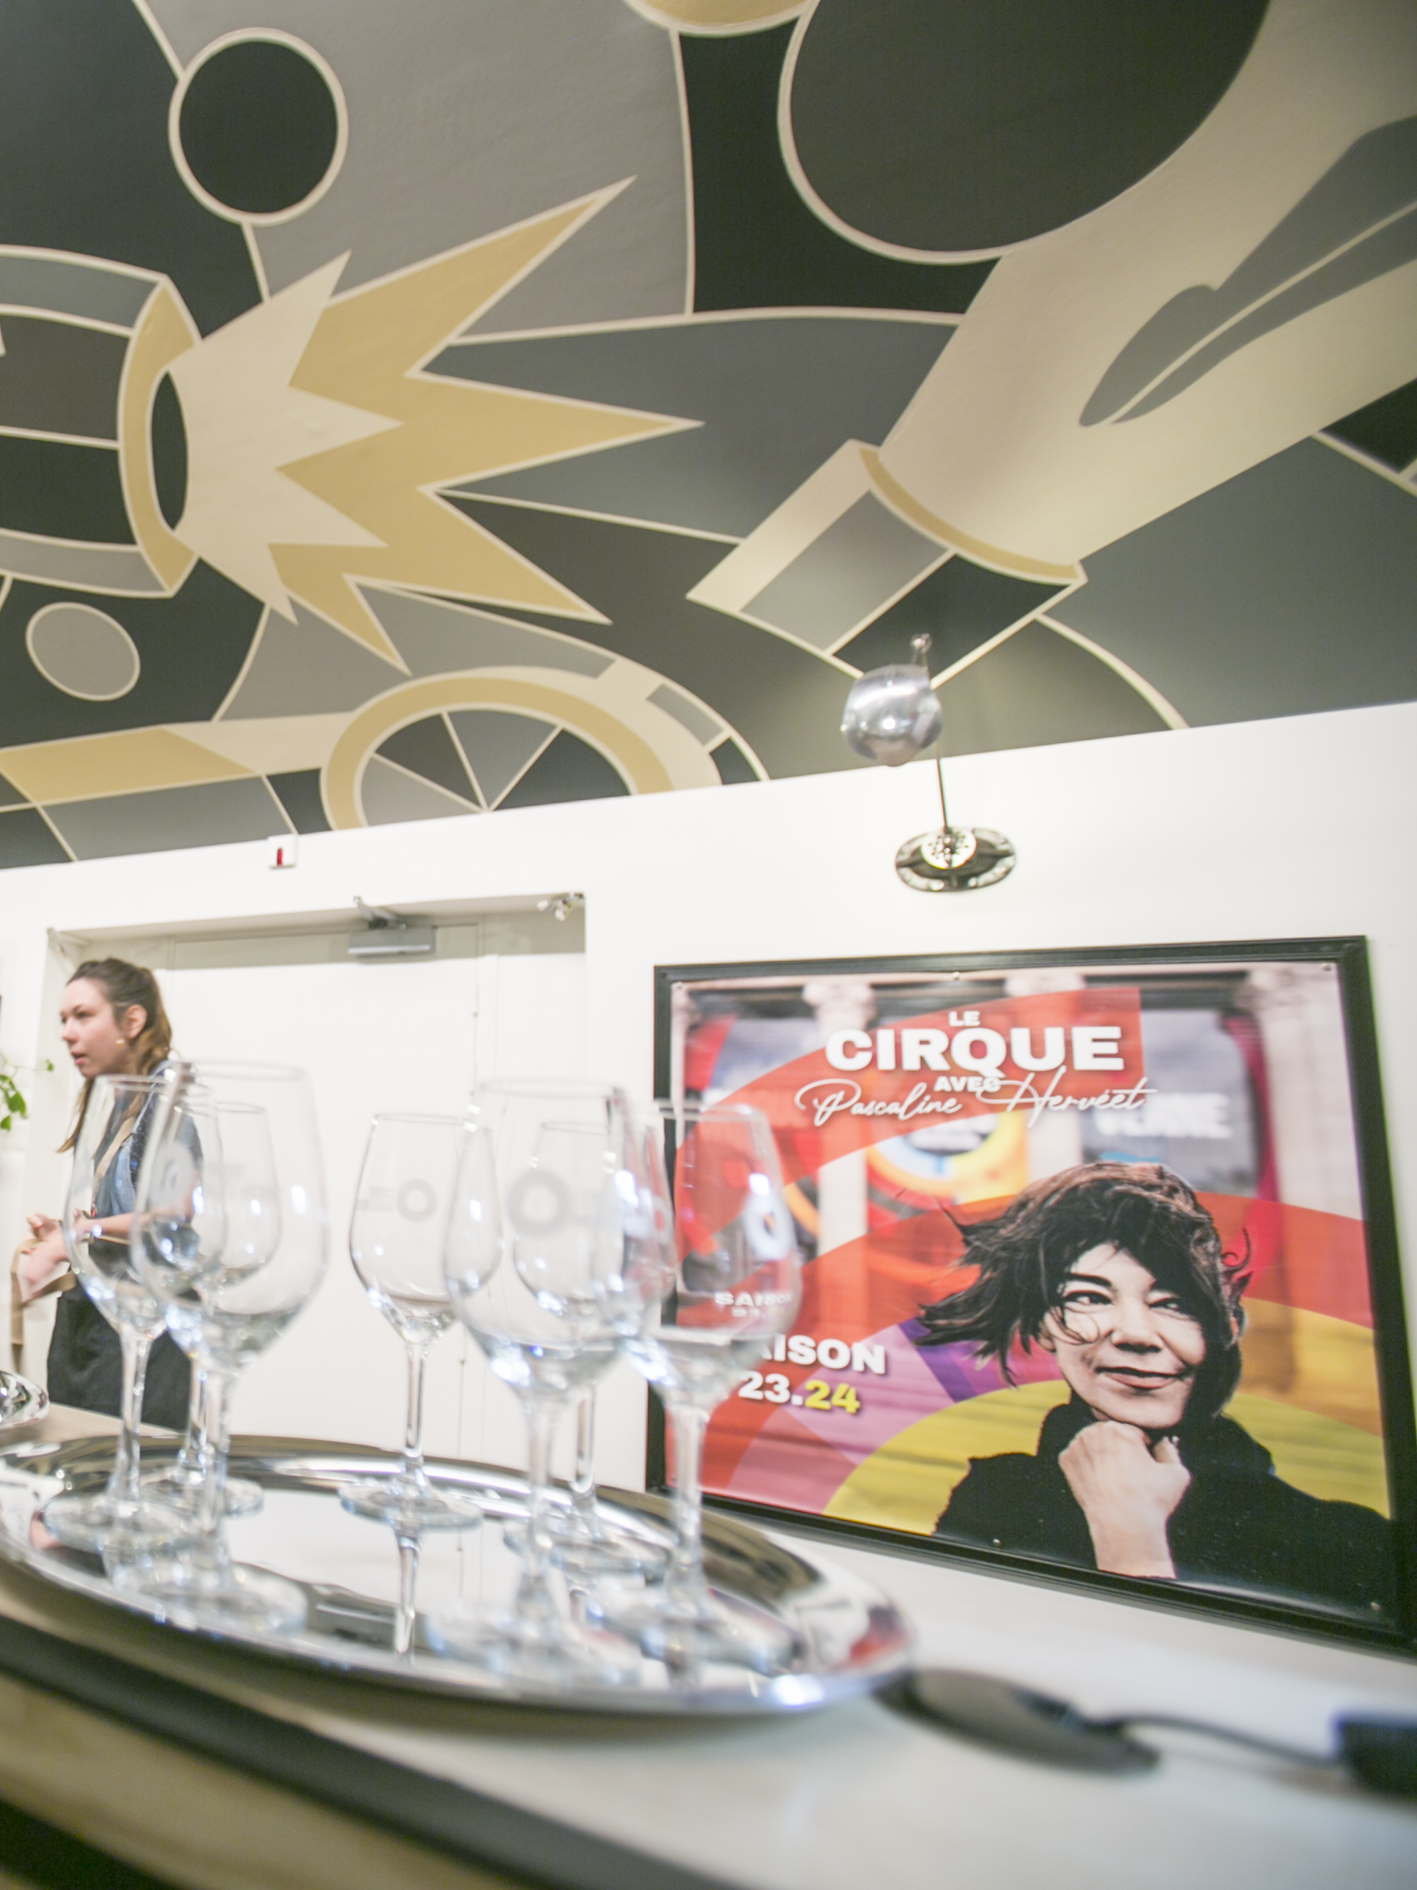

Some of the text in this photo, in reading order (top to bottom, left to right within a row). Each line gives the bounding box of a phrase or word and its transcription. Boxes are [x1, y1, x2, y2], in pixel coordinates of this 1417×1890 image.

[948, 1011, 981, 1027] LE
[825, 1026, 1125, 1079] CIRQUE
[794, 1078, 964, 1127] Pascaline
[934, 1076, 1002, 1093] AVEC
[759, 1333, 886, 1375] ISON
[738, 1371, 861, 1414] 23.24
